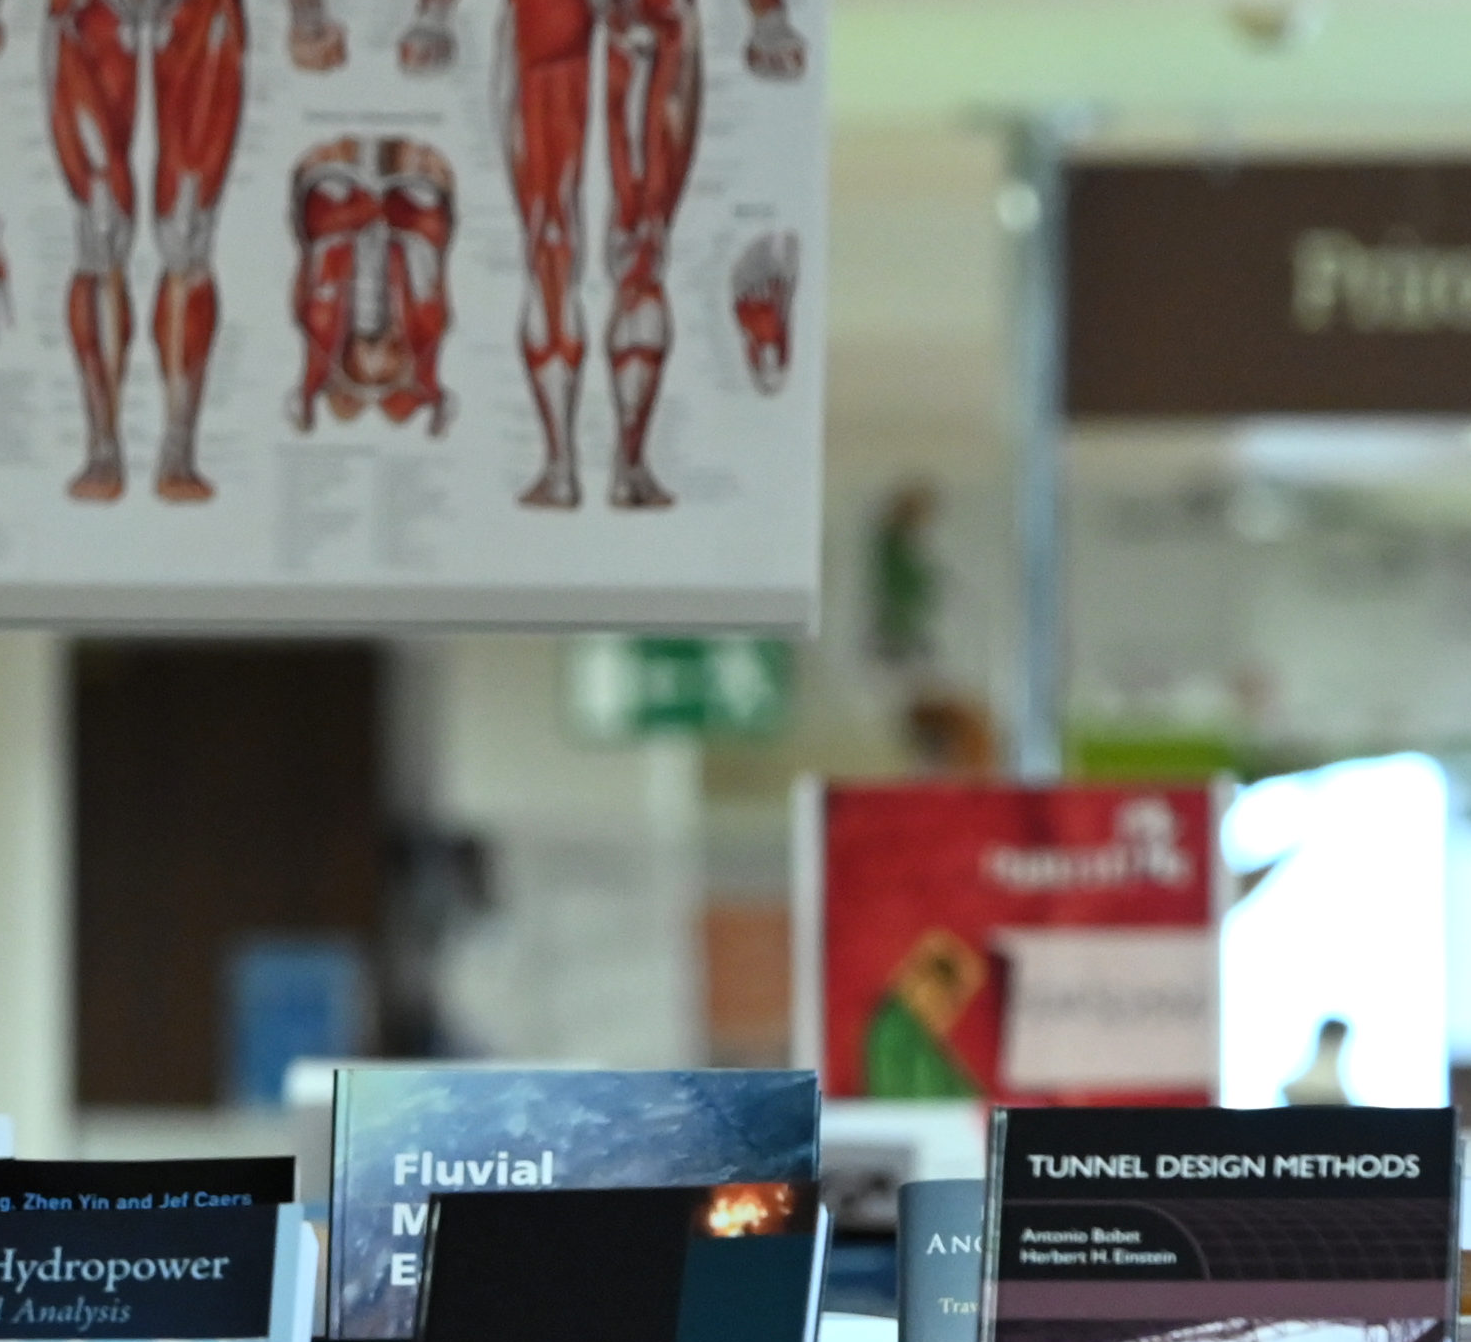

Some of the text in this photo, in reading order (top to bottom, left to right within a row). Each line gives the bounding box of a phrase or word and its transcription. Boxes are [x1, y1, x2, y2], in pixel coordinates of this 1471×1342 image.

[394, 1151, 554, 1186] Fluvial
[1028, 1154, 1421, 1179] TUNNEL DESIGN METHODS
[24, 1193, 73, 1210] Zhen
[79, 1193, 109, 1209] Yin
[117, 1193, 153, 1209] and
[160, 1192, 190, 1208] Jef
[195, 1191, 252, 1207] Caers
[1021, 1228, 1142, 1244] Antonio Bobet
[1020, 1250, 1087, 1265] Herbert
[1113, 1249, 1178, 1265] Einstein
[11, 1295, 132, 1332] Analysis
